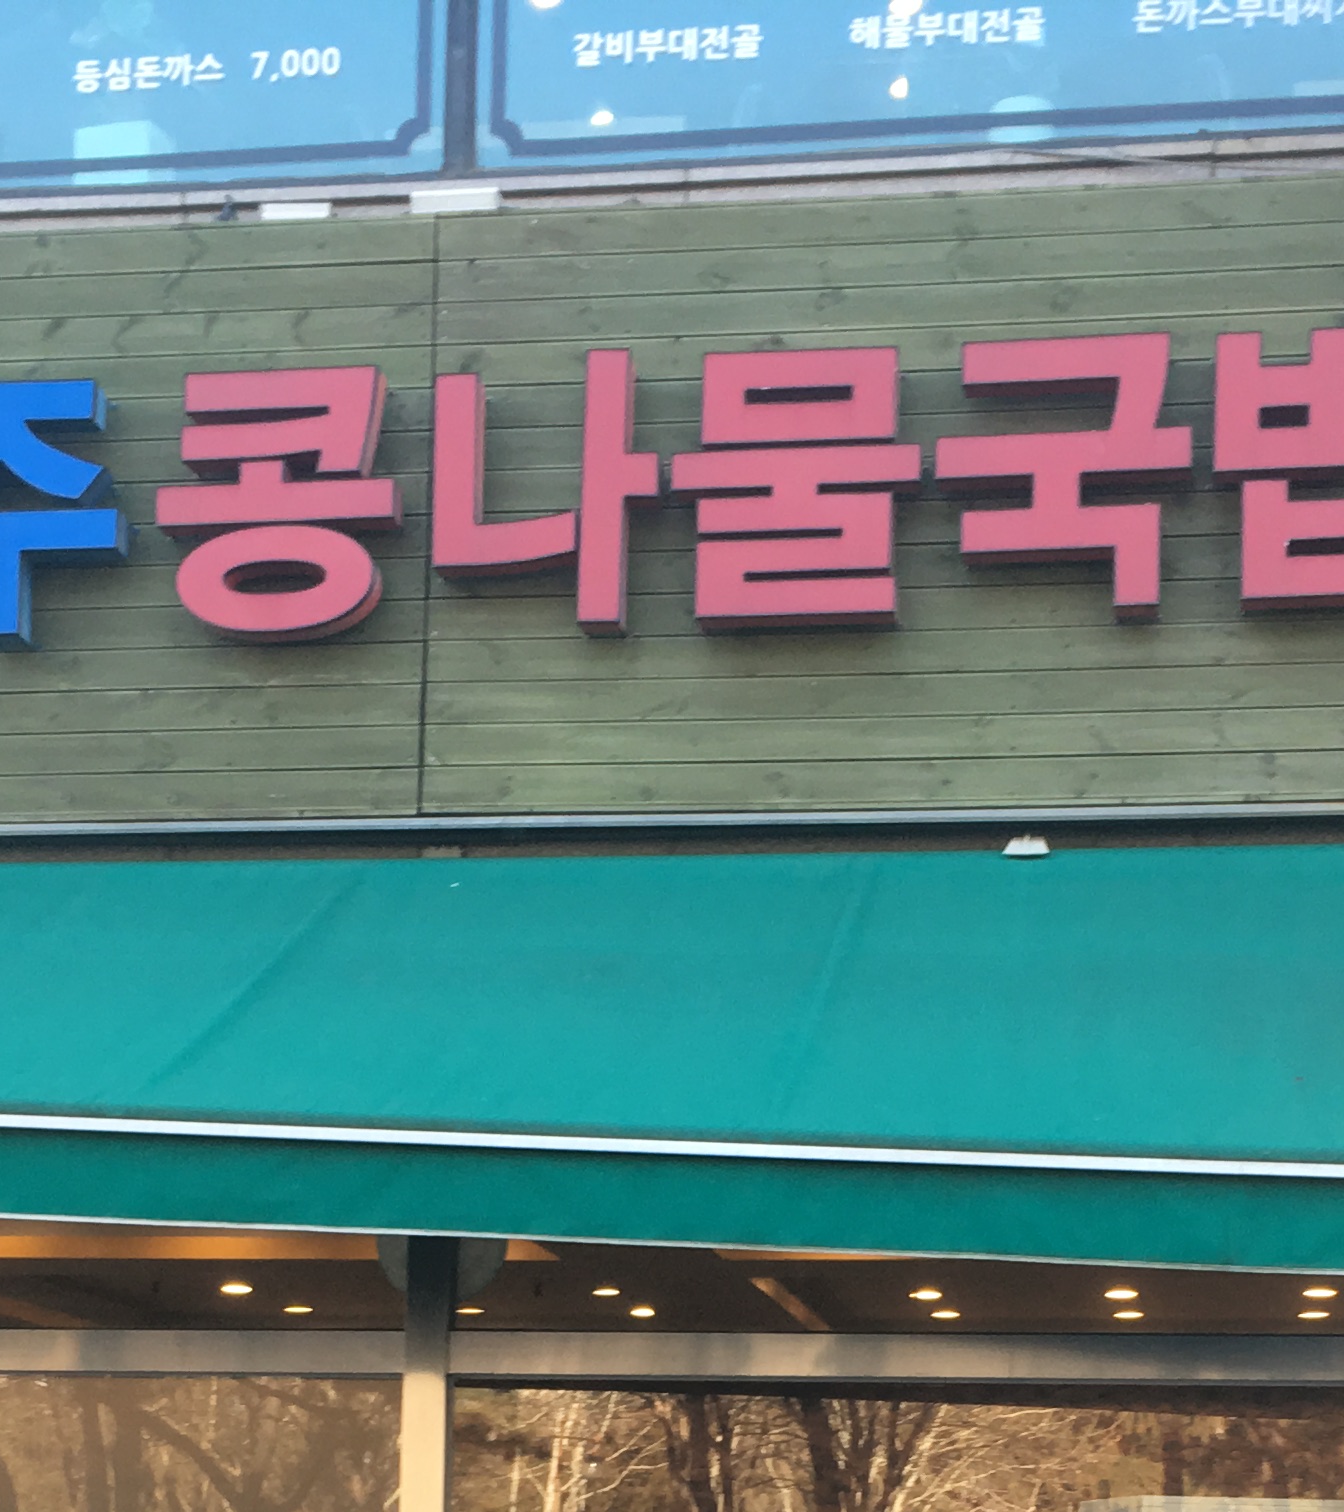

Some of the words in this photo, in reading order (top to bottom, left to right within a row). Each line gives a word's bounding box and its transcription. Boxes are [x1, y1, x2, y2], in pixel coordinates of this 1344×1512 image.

[572, 23, 764, 68] 갈비부대전골
[848, 6, 1047, 50] 해물부대전골
[72, 53, 226, 94] 등심돈까스
[250, 46, 342, 83] 7,000
